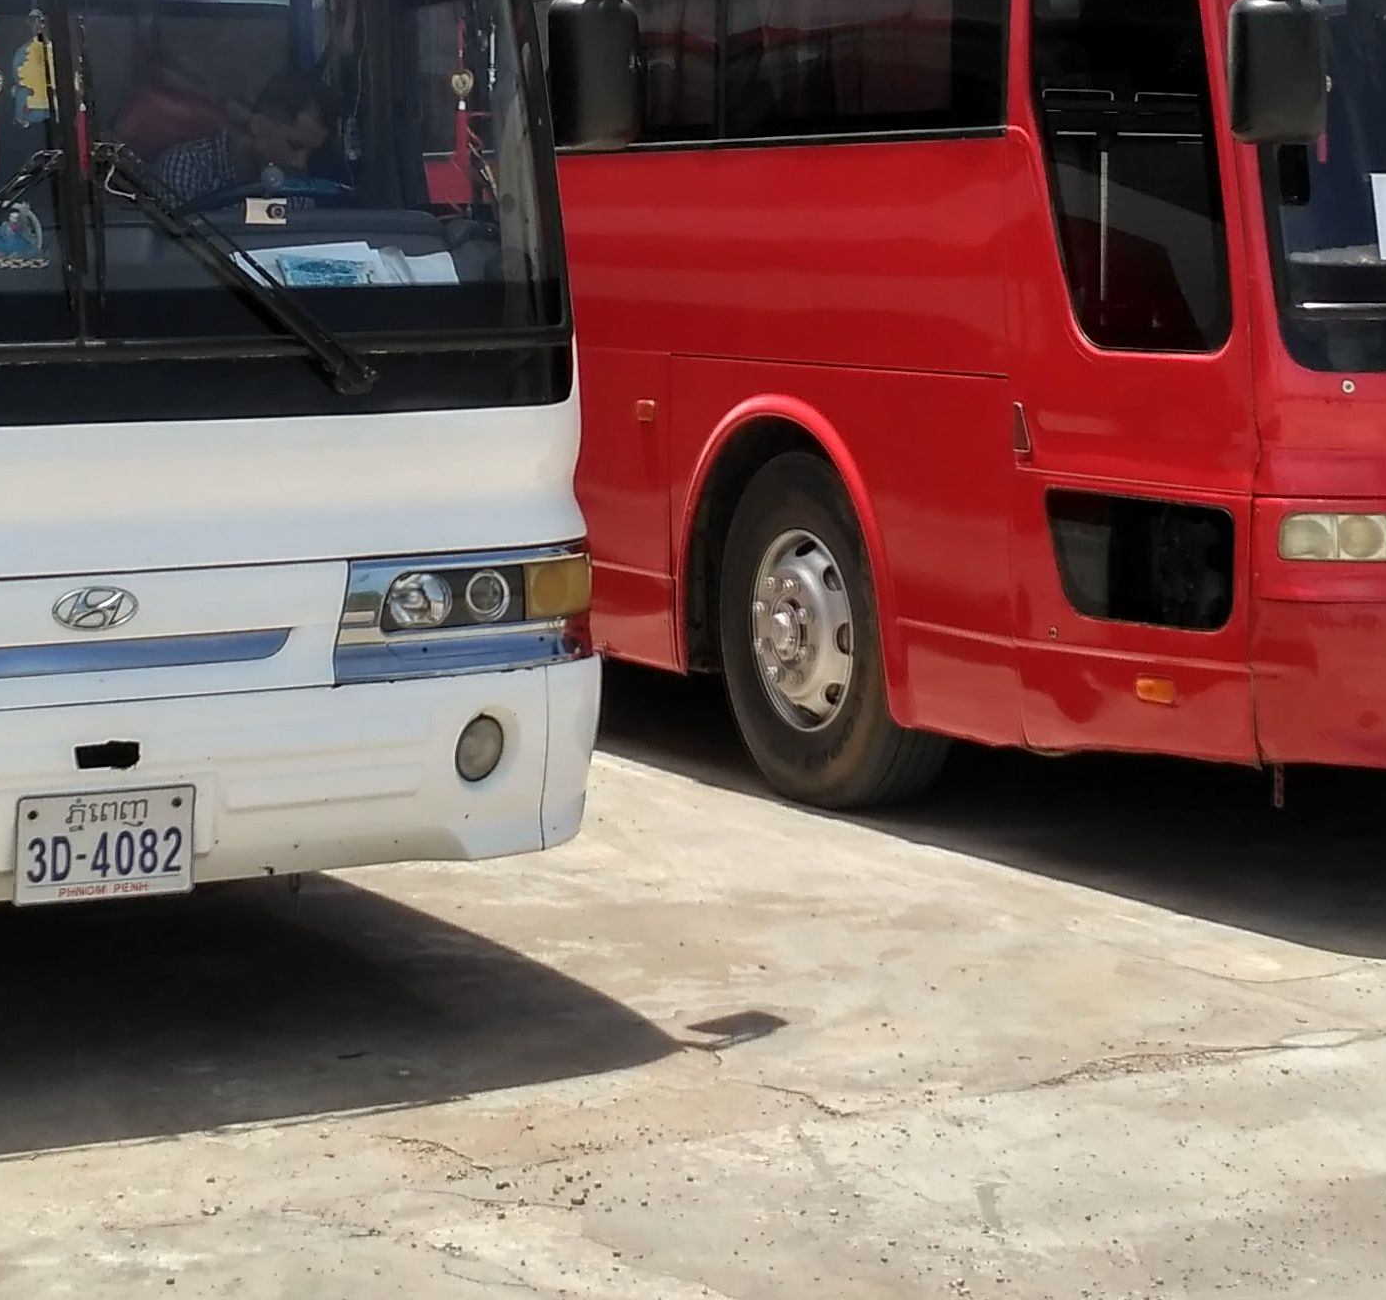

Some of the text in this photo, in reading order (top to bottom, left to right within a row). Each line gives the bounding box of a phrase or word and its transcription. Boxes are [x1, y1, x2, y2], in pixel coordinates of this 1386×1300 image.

[26, 826, 183, 884] 3D-4082
[58, 881, 150, 898] PHNOM PENH
